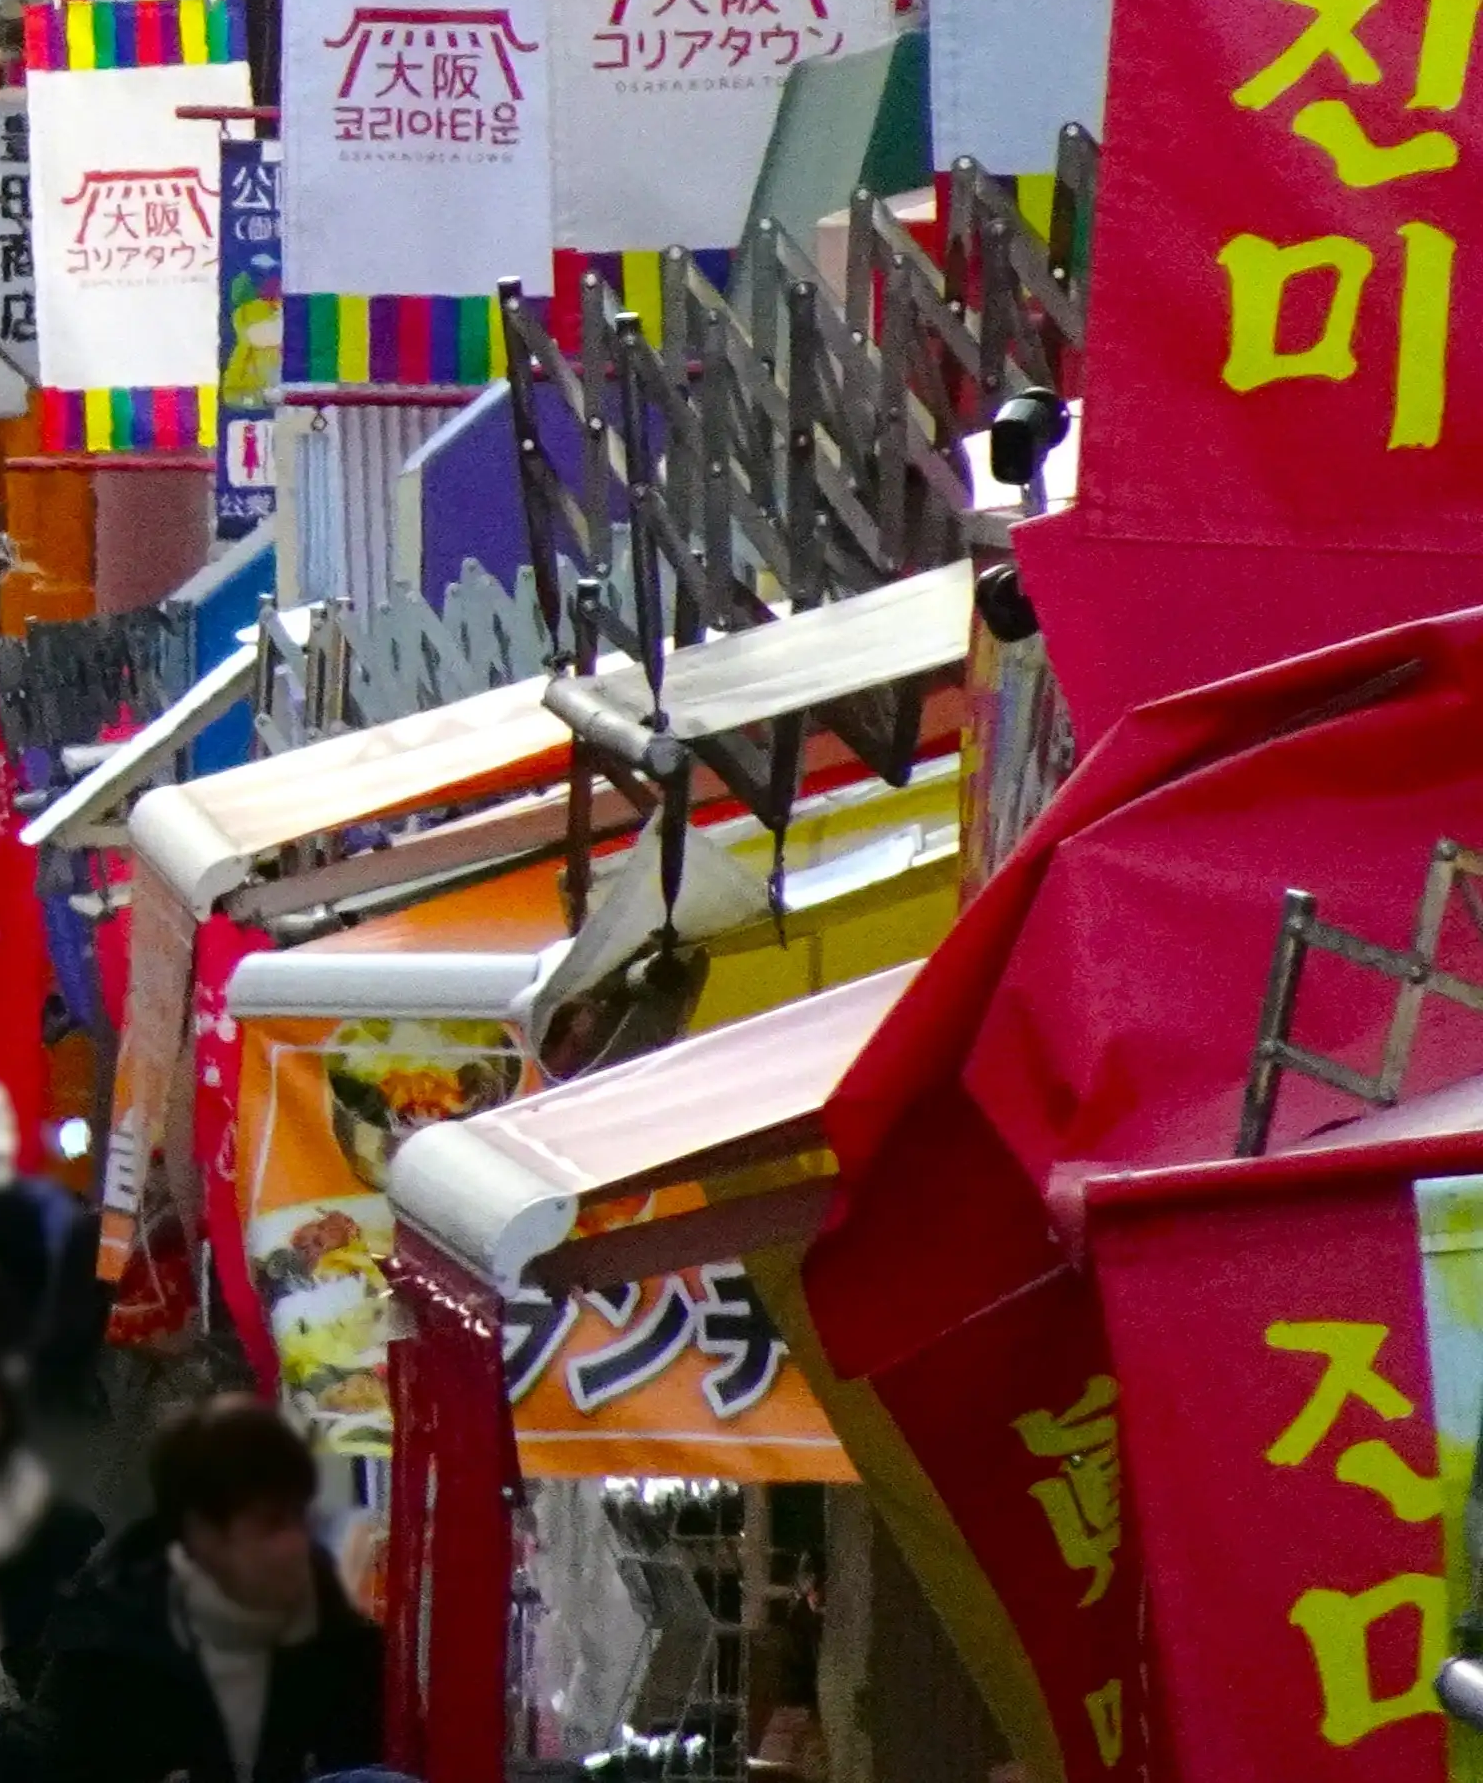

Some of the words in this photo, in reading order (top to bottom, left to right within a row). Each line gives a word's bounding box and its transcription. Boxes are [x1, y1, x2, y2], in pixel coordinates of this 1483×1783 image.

[375, 53, 480, 101] 大阪
[334, 103, 521, 146] 코리아타운
[103, 201, 183, 239] 大阪
[66, 241, 220, 274] コリアタウン
